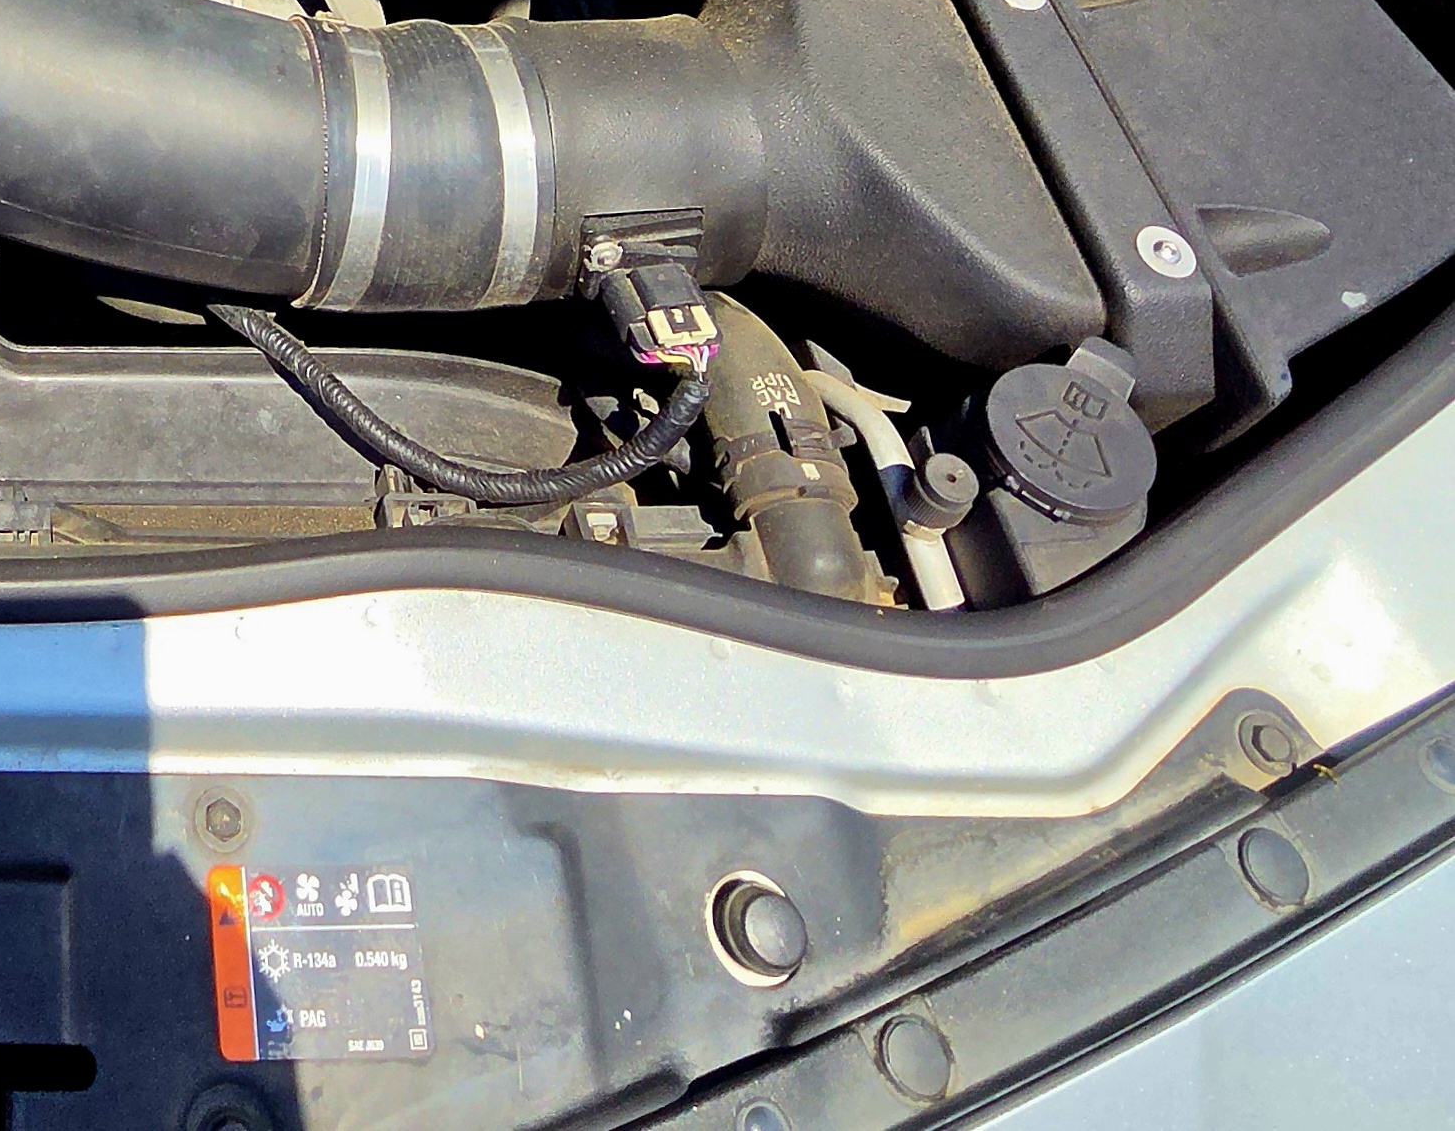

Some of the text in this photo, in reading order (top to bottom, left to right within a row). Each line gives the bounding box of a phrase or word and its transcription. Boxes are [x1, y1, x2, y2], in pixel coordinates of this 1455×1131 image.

[296, 903, 324, 917] AUTO
[293, 950, 408, 970] R-134a 0.540 kg
[300, 1009, 327, 1028] PAG
